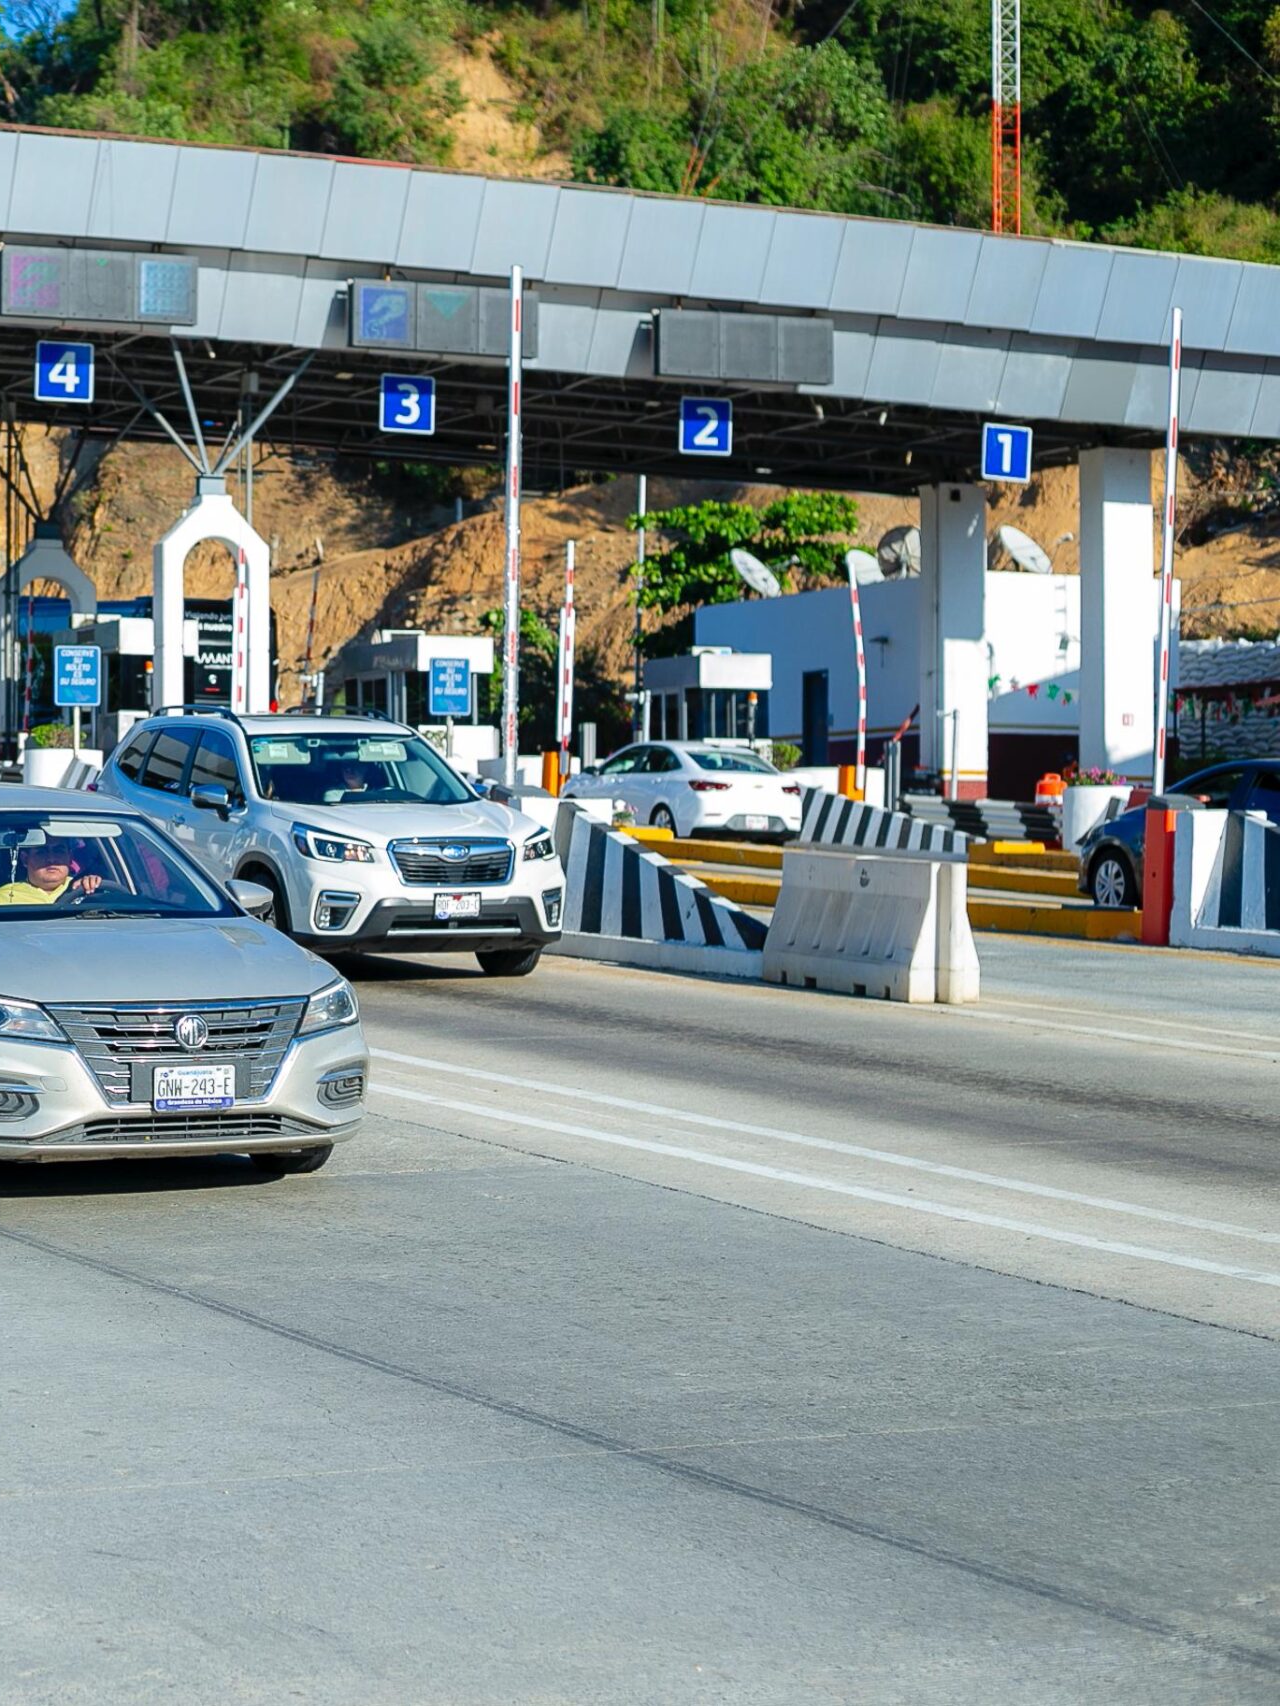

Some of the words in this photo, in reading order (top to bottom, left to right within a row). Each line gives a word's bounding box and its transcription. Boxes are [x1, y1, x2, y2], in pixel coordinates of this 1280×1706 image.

[48, 351, 81, 393] 4
[394, 383, 421, 425] 3
[693, 406, 720, 447] 2
[996, 433, 1013, 473] 1
[60, 649, 95, 657] CONSERVE
[73, 656, 83, 664] SU
[435, 660, 466, 668] CONSERVE
[65, 663, 91, 671] BOLETO
[73, 670, 83, 678] ES
[438, 673, 463, 681] BOLETO
[60, 677, 70, 686] SU
[70, 677, 96, 686] SEGURO
[444, 687, 468, 696] SEGURO
[180, 1017, 205, 1046] MG
[157, 1077, 232, 1098] GNW-243-E
